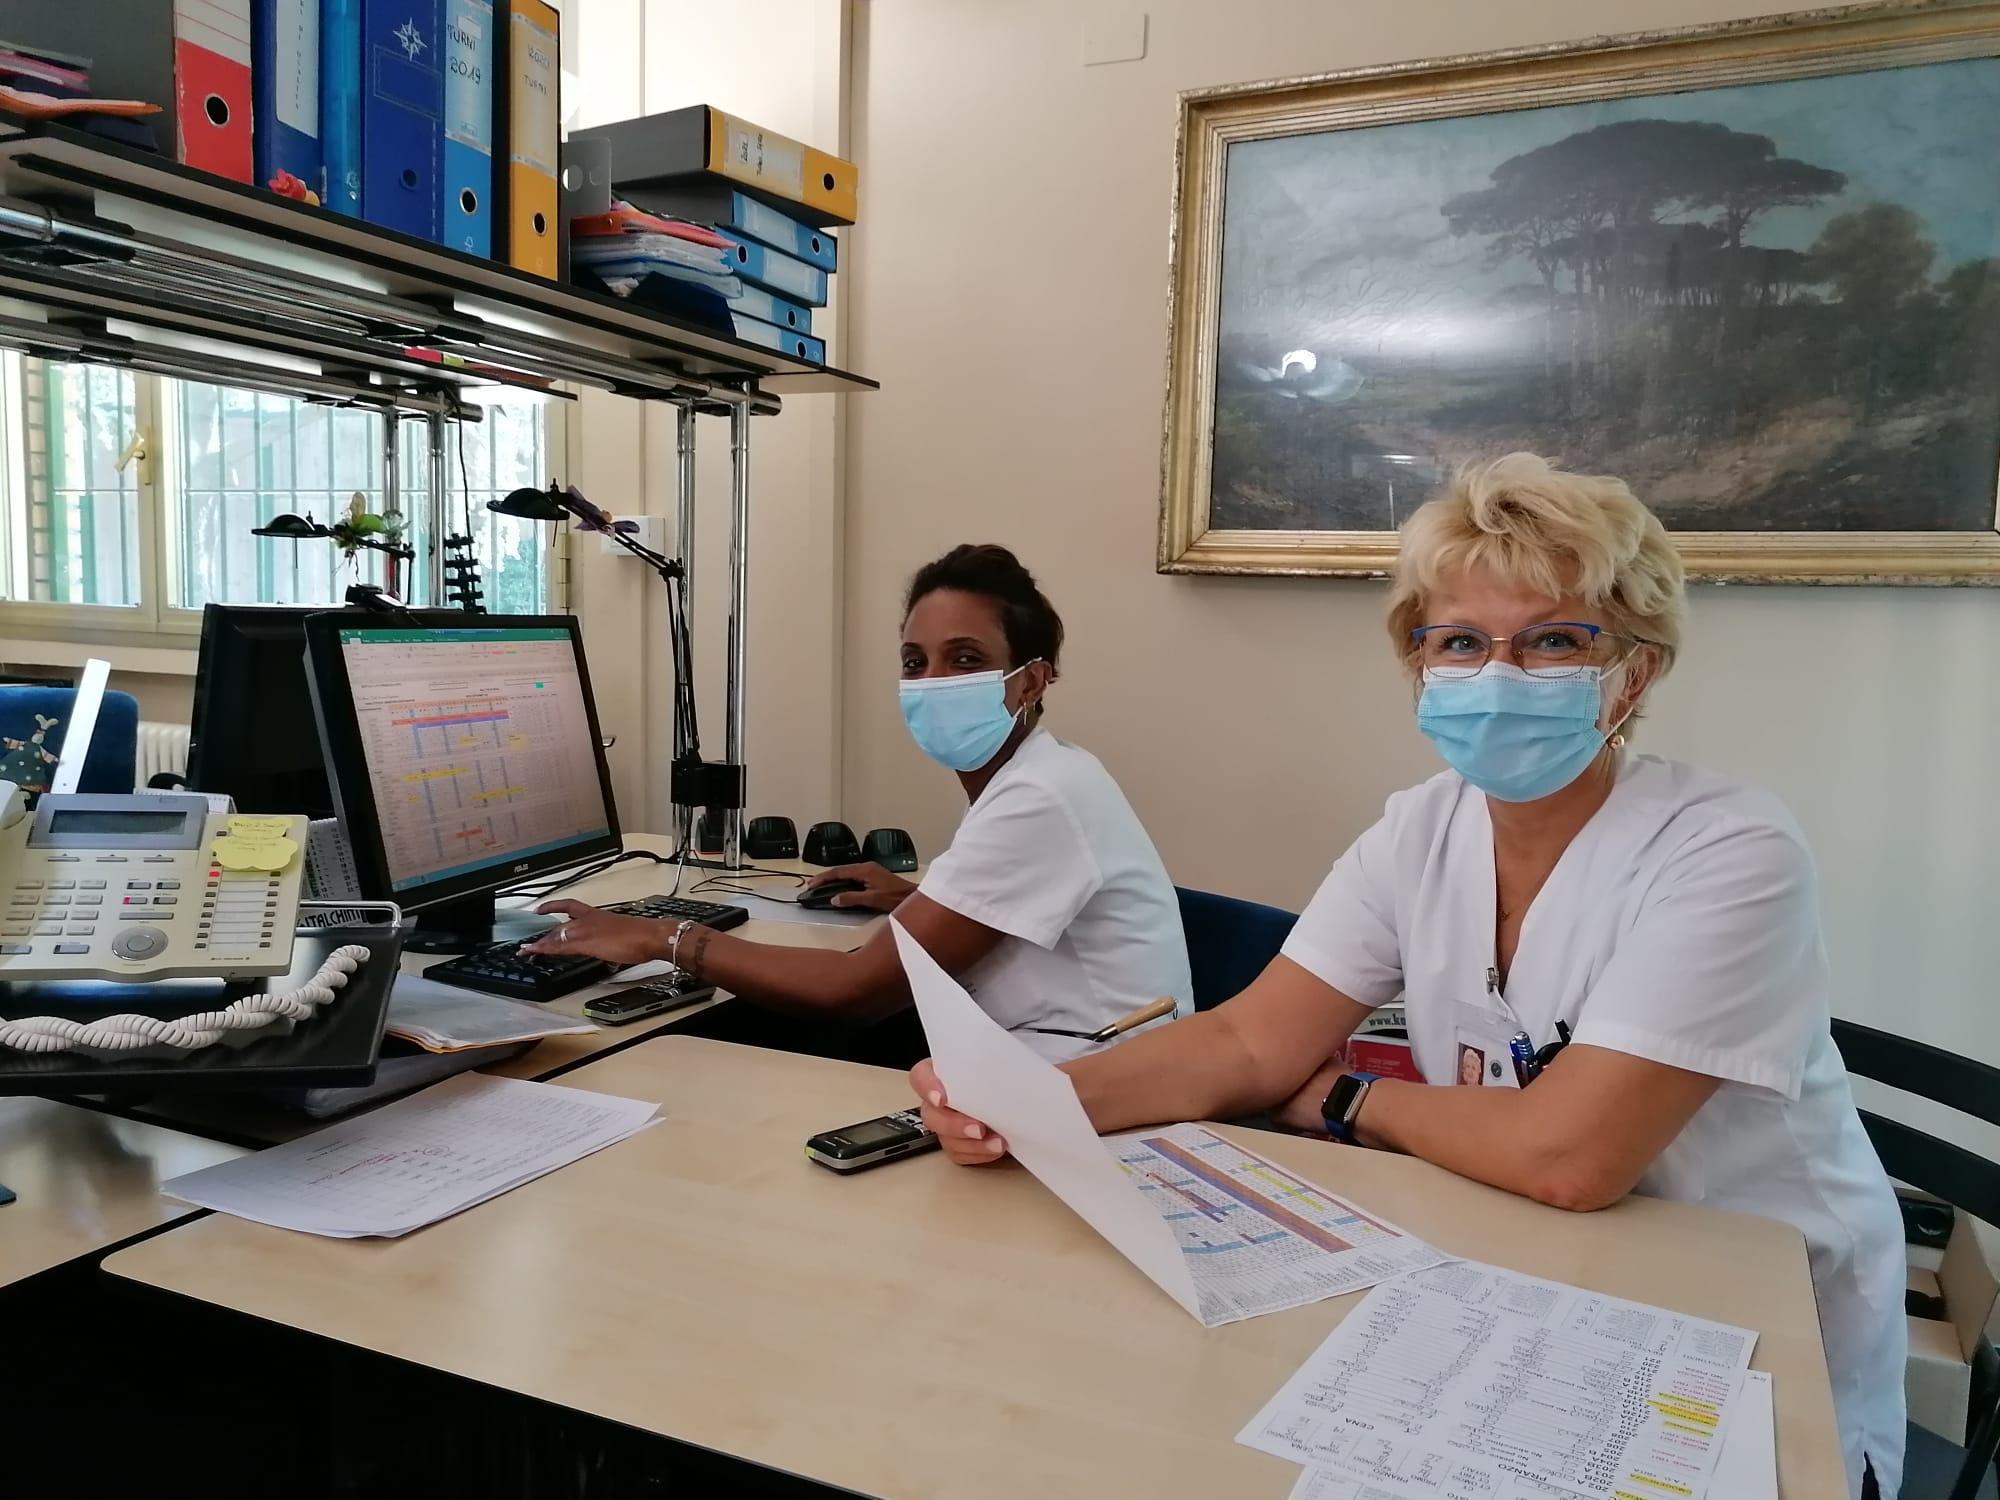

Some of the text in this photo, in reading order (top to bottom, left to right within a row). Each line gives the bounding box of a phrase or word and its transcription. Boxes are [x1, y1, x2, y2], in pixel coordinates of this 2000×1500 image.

[447, 24, 476, 52] TURNI
[449, 56, 481, 85] 2019
[1345, 1418, 1374, 1430] CENA
[1498, 1464, 1547, 1482] PRANZO
[1588, 1482, 1608, 1492] 202
